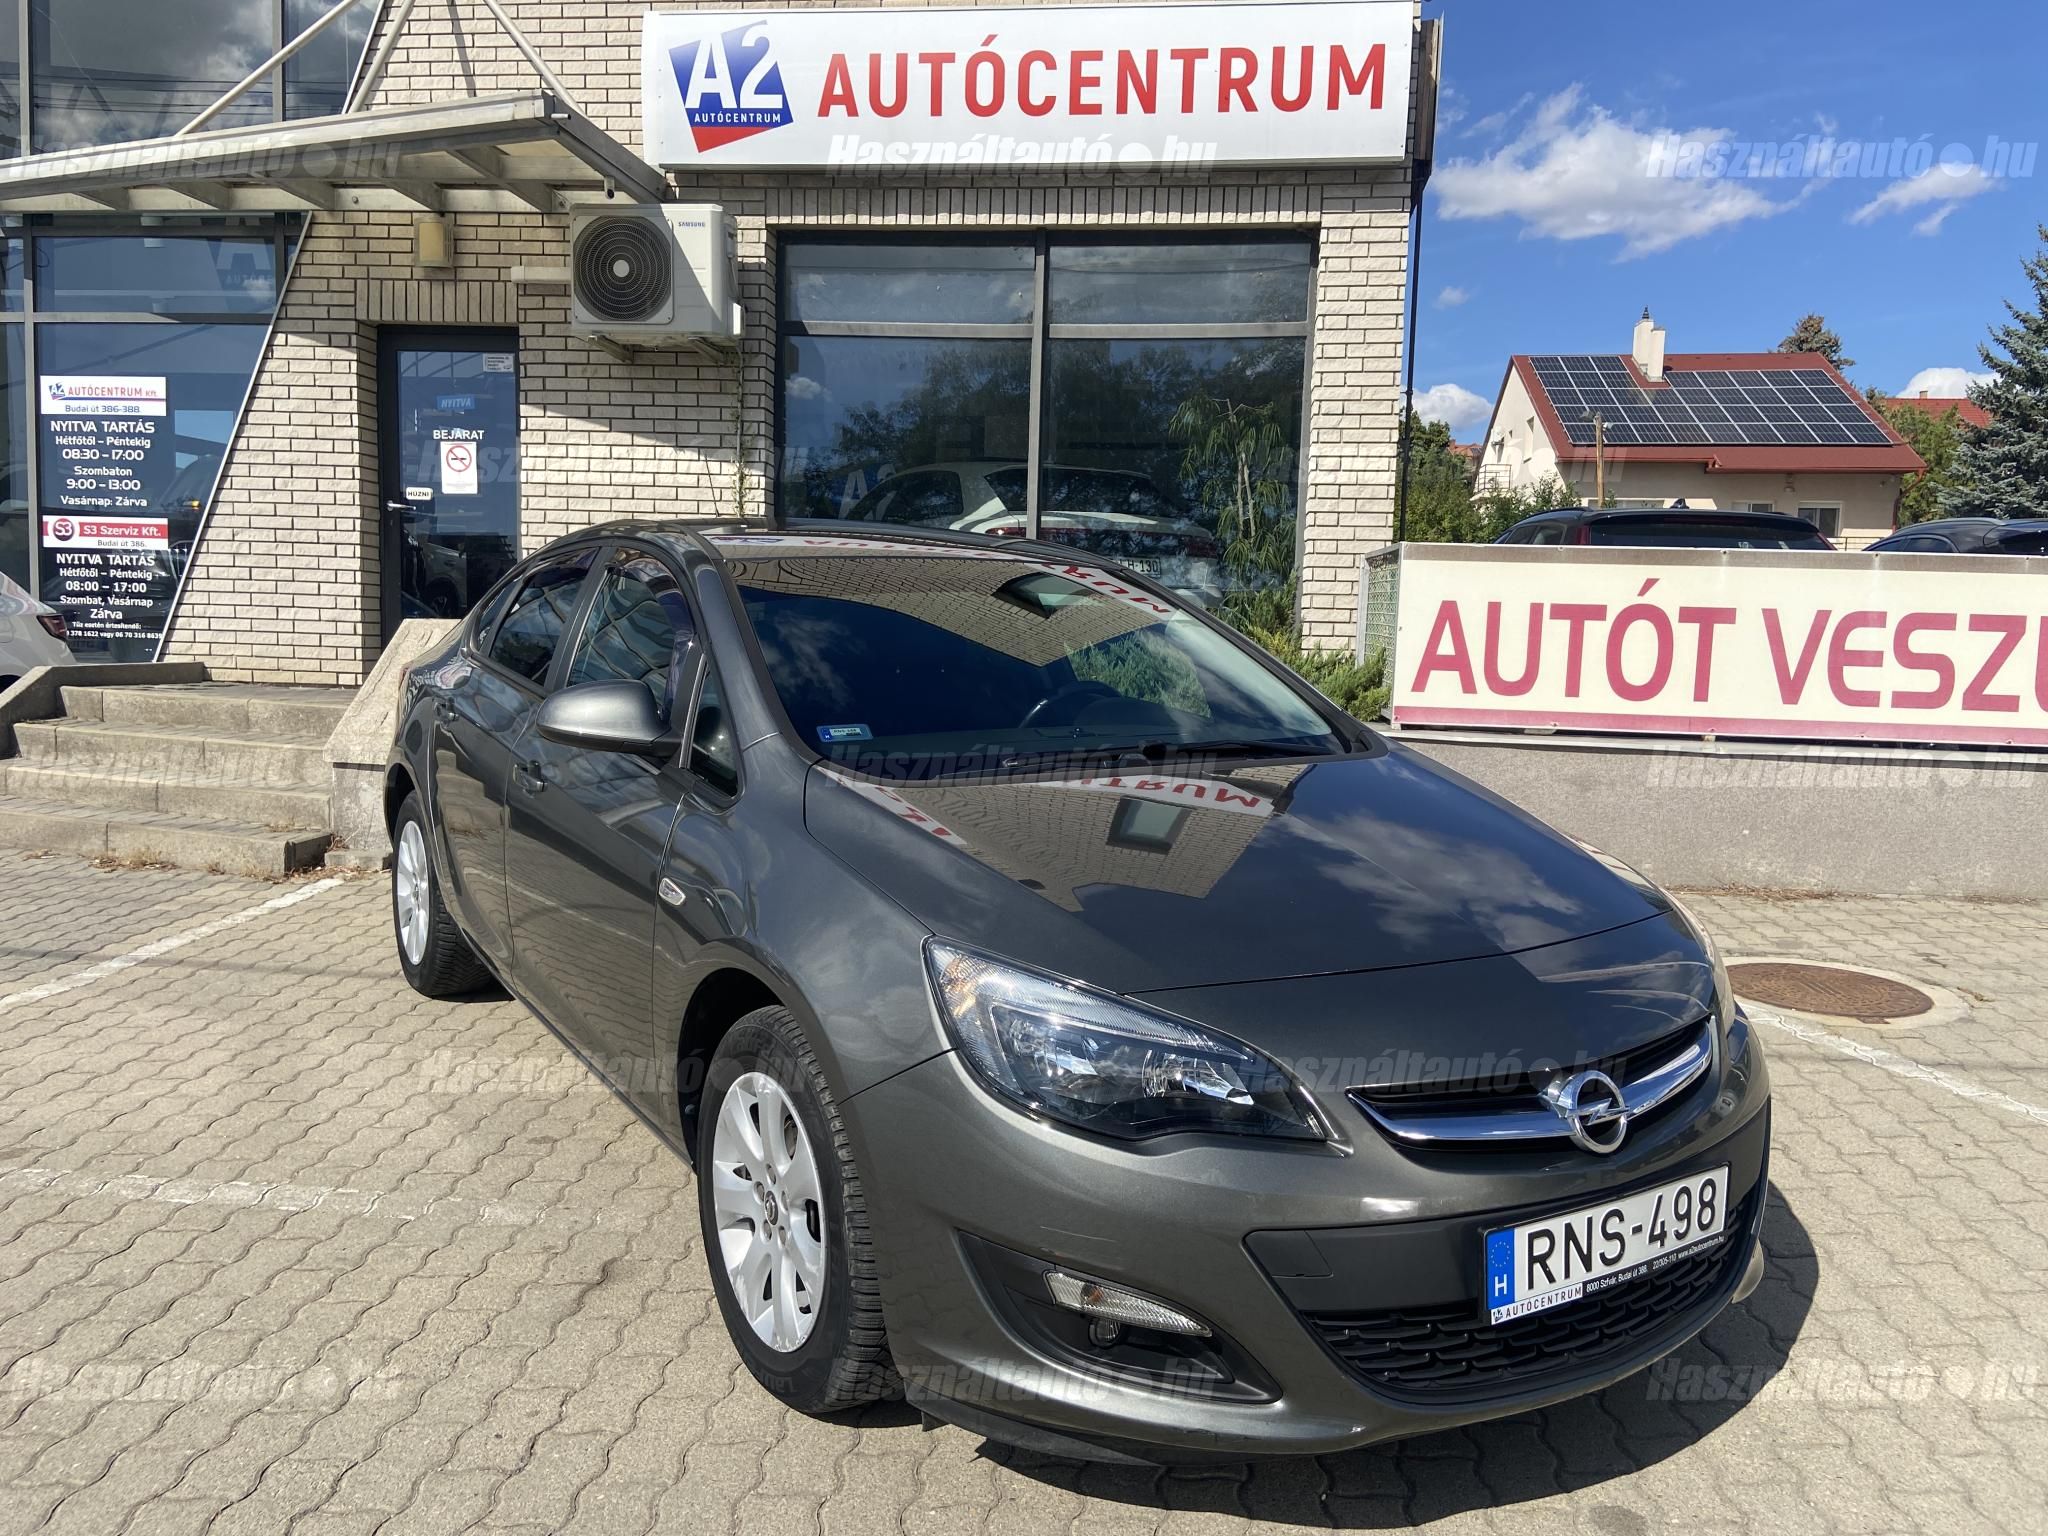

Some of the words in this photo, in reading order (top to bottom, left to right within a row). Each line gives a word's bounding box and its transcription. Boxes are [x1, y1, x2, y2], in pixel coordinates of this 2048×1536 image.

[685, 24, 783, 109] A2
[817, 33, 1387, 118] AUTÓCENTRUM
[694, 111, 781, 123] AUTÓCENTRUM
[68, 385, 142, 397] AUTÓCENTRUM
[65, 404, 89, 413] Budai
[91, 403, 99, 413] út
[50, 420, 97, 432] NYITVA
[101, 418, 155, 433] TARTÁS
[55, 436, 96, 446] Hétfőtől
[106, 436, 151, 449] Péntekig
[62, 449, 100, 460] 08:30
[111, 449, 144, 460] 17:00
[74, 465, 133, 476] Szombaton
[66, 478, 96, 489] 9:00
[108, 479, 141, 490] 13:00
[60, 495, 113, 507] Vasárnap:
[115, 496, 148, 507] Zárva
[55, 521, 73, 536] S3
[83, 525, 98, 535] S3
[100, 525, 139, 536] Szerviz
[142, 526, 161, 536] Kft.
[97, 539, 119, 547] Budai
[56, 553, 103, 564] NYITVA
[107, 552, 156, 566] TARTÁS
[59, 568, 99, 578] Hétfőtől
[109, 568, 153, 580] Péntekig
[65, 581, 99, 591] 08:00
[113, 582, 147, 593] 17:00
[60, 595, 105, 606] Szombat,
[107, 595, 153, 608] Vasárnap
[90, 608, 123, 619] Zárva
[1411, 578, 1738, 702] AUTÓT
[1761, 607, 2048, 713] VESZ
[1527, 1177, 1716, 1290] RNS-498
[1494, 1273, 1508, 1297] H
[1586, 1280, 1600, 1293] 8000
[1506, 1287, 1582, 1318] AUTÓCENTRUM
